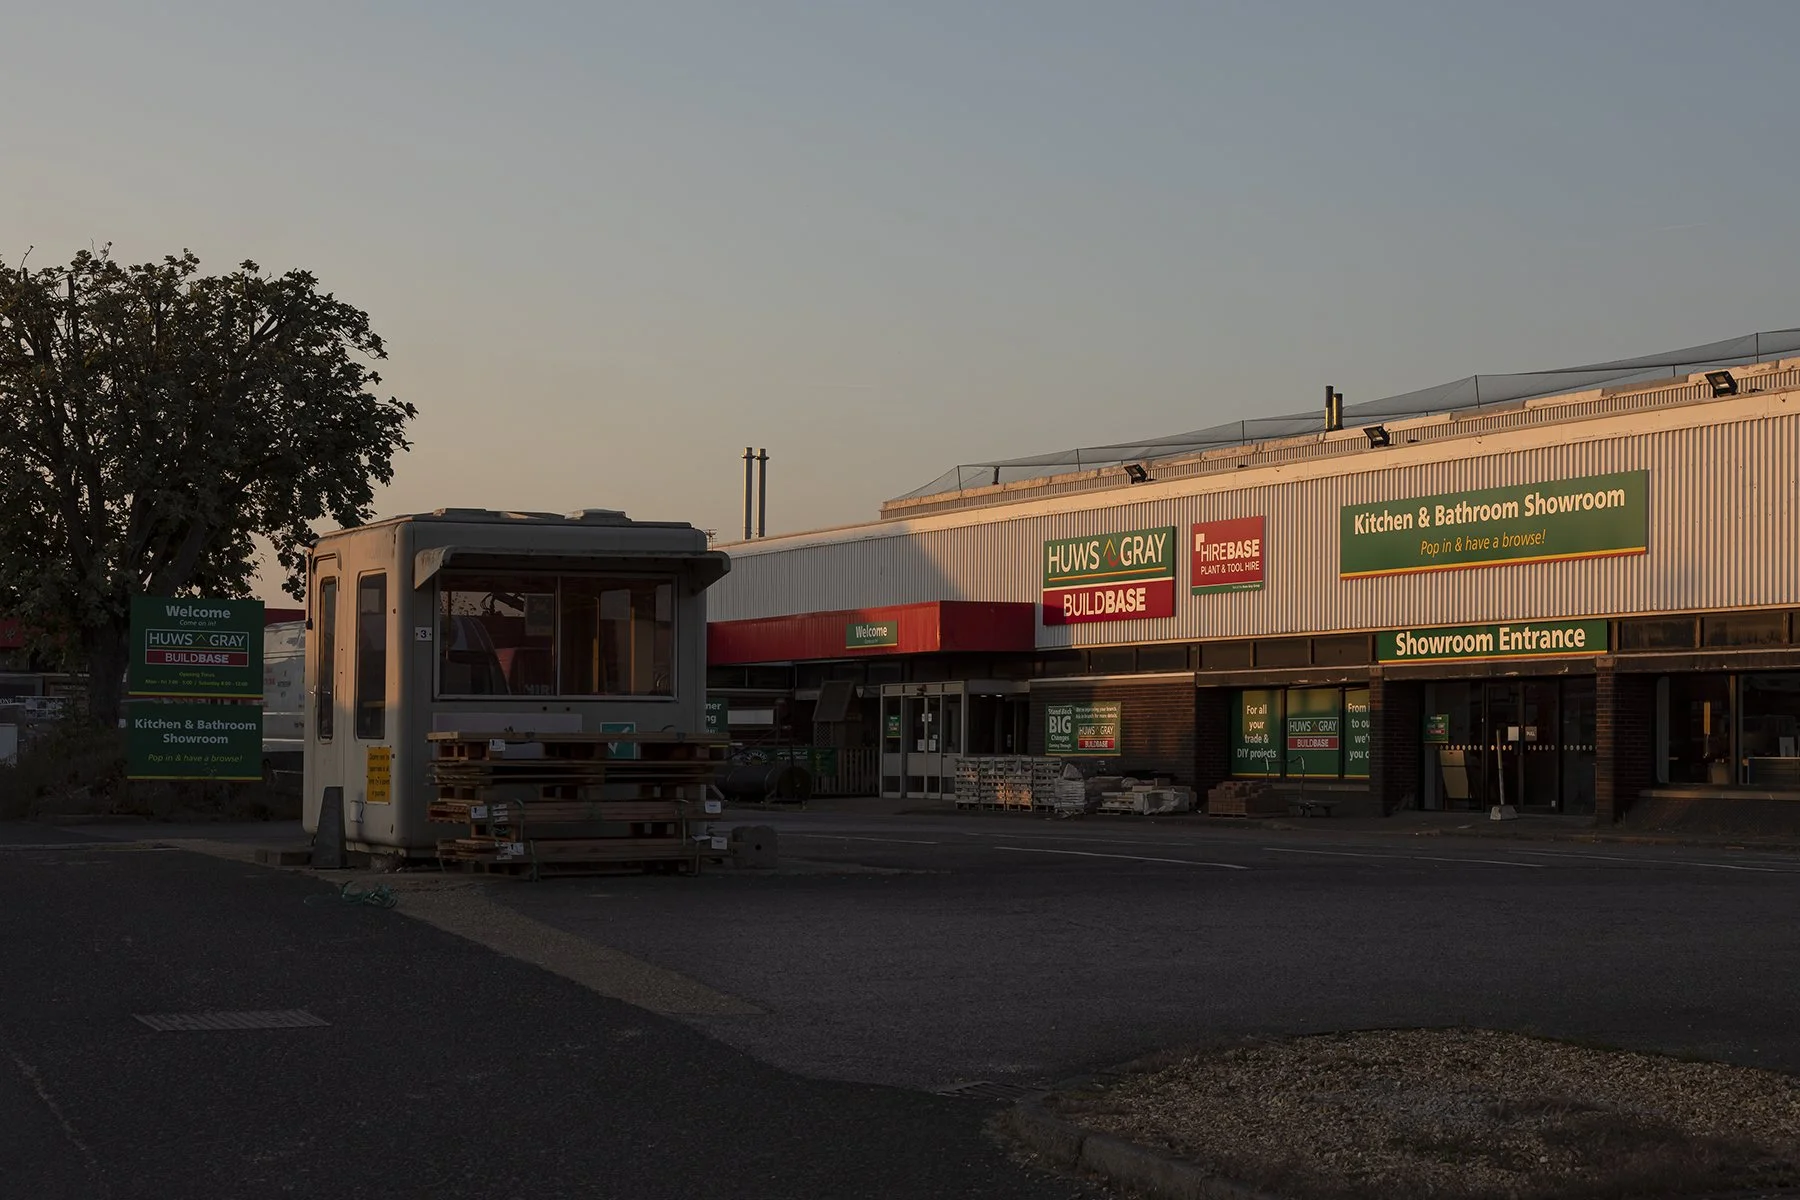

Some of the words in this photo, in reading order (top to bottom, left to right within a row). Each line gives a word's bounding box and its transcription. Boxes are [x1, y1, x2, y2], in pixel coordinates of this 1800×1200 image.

[1354, 509, 1413, 535] Kitchen
[1418, 506, 1430, 528] &
[1435, 500, 1519, 526] Bathroom
[1524, 488, 1625, 517] Showroom
[1420, 540, 1440, 558] Pop
[1442, 538, 1452, 553] in
[1455, 536, 1462, 552] &
[1465, 534, 1490, 551] have
[1492, 536, 1499, 549] a
[1502, 528, 1546, 548] browse!
[1048, 540, 1100, 574] HUWS
[1120, 532, 1167, 567] GRAY
[1200, 538, 1260, 562] HIREBASE
[1200, 564, 1220, 576] PLANT
[1221, 563, 1226, 574] &
[1227, 562, 1244, 573] TOOL
[1245, 560, 1260, 571] HIRE
[1063, 587, 1147, 618] BUILDBASE
[165, 605, 231, 619] Welcome
[179, 619, 198, 627] Come
[420, 629, 427, 639] 3
[855, 624, 887, 638] Welcome
[149, 632, 193, 645] HUWS
[209, 634, 245, 647] GRAY
[1395, 631, 1494, 656] Showroom
[1499, 626, 1586, 651] Entrance
[165, 652, 230, 664] BUILDBASE
[1246, 705, 1258, 715] For
[1259, 704, 1267, 714] all
[1348, 703, 1366, 713] From
[134, 719, 182, 730] Kitchen
[184, 720, 195, 730] &
[197, 720, 257, 731] Bathroom
[1049, 716, 1071, 733] BIG
[1249, 721, 1265, 731] your
[1290, 720, 1311, 732] HUWS
[1318, 720, 1337, 732] GRAY
[1351, 718, 1359, 728] to
[1080, 725, 1095, 735] HUWS
[1100, 725, 1114, 735] GRAY
[162, 733, 229, 744] Showroom
[1244, 733, 1262, 744] trade
[1263, 734, 1269, 744] &
[1297, 738, 1329, 748] BUILDBASE
[148, 753, 164, 763] Pop
[184, 754, 202, 762] have
[211, 754, 243, 763] browse!
[1236, 748, 1249, 759] DIY
[1250, 748, 1277, 760] projects
[1349, 751, 1363, 762] you
